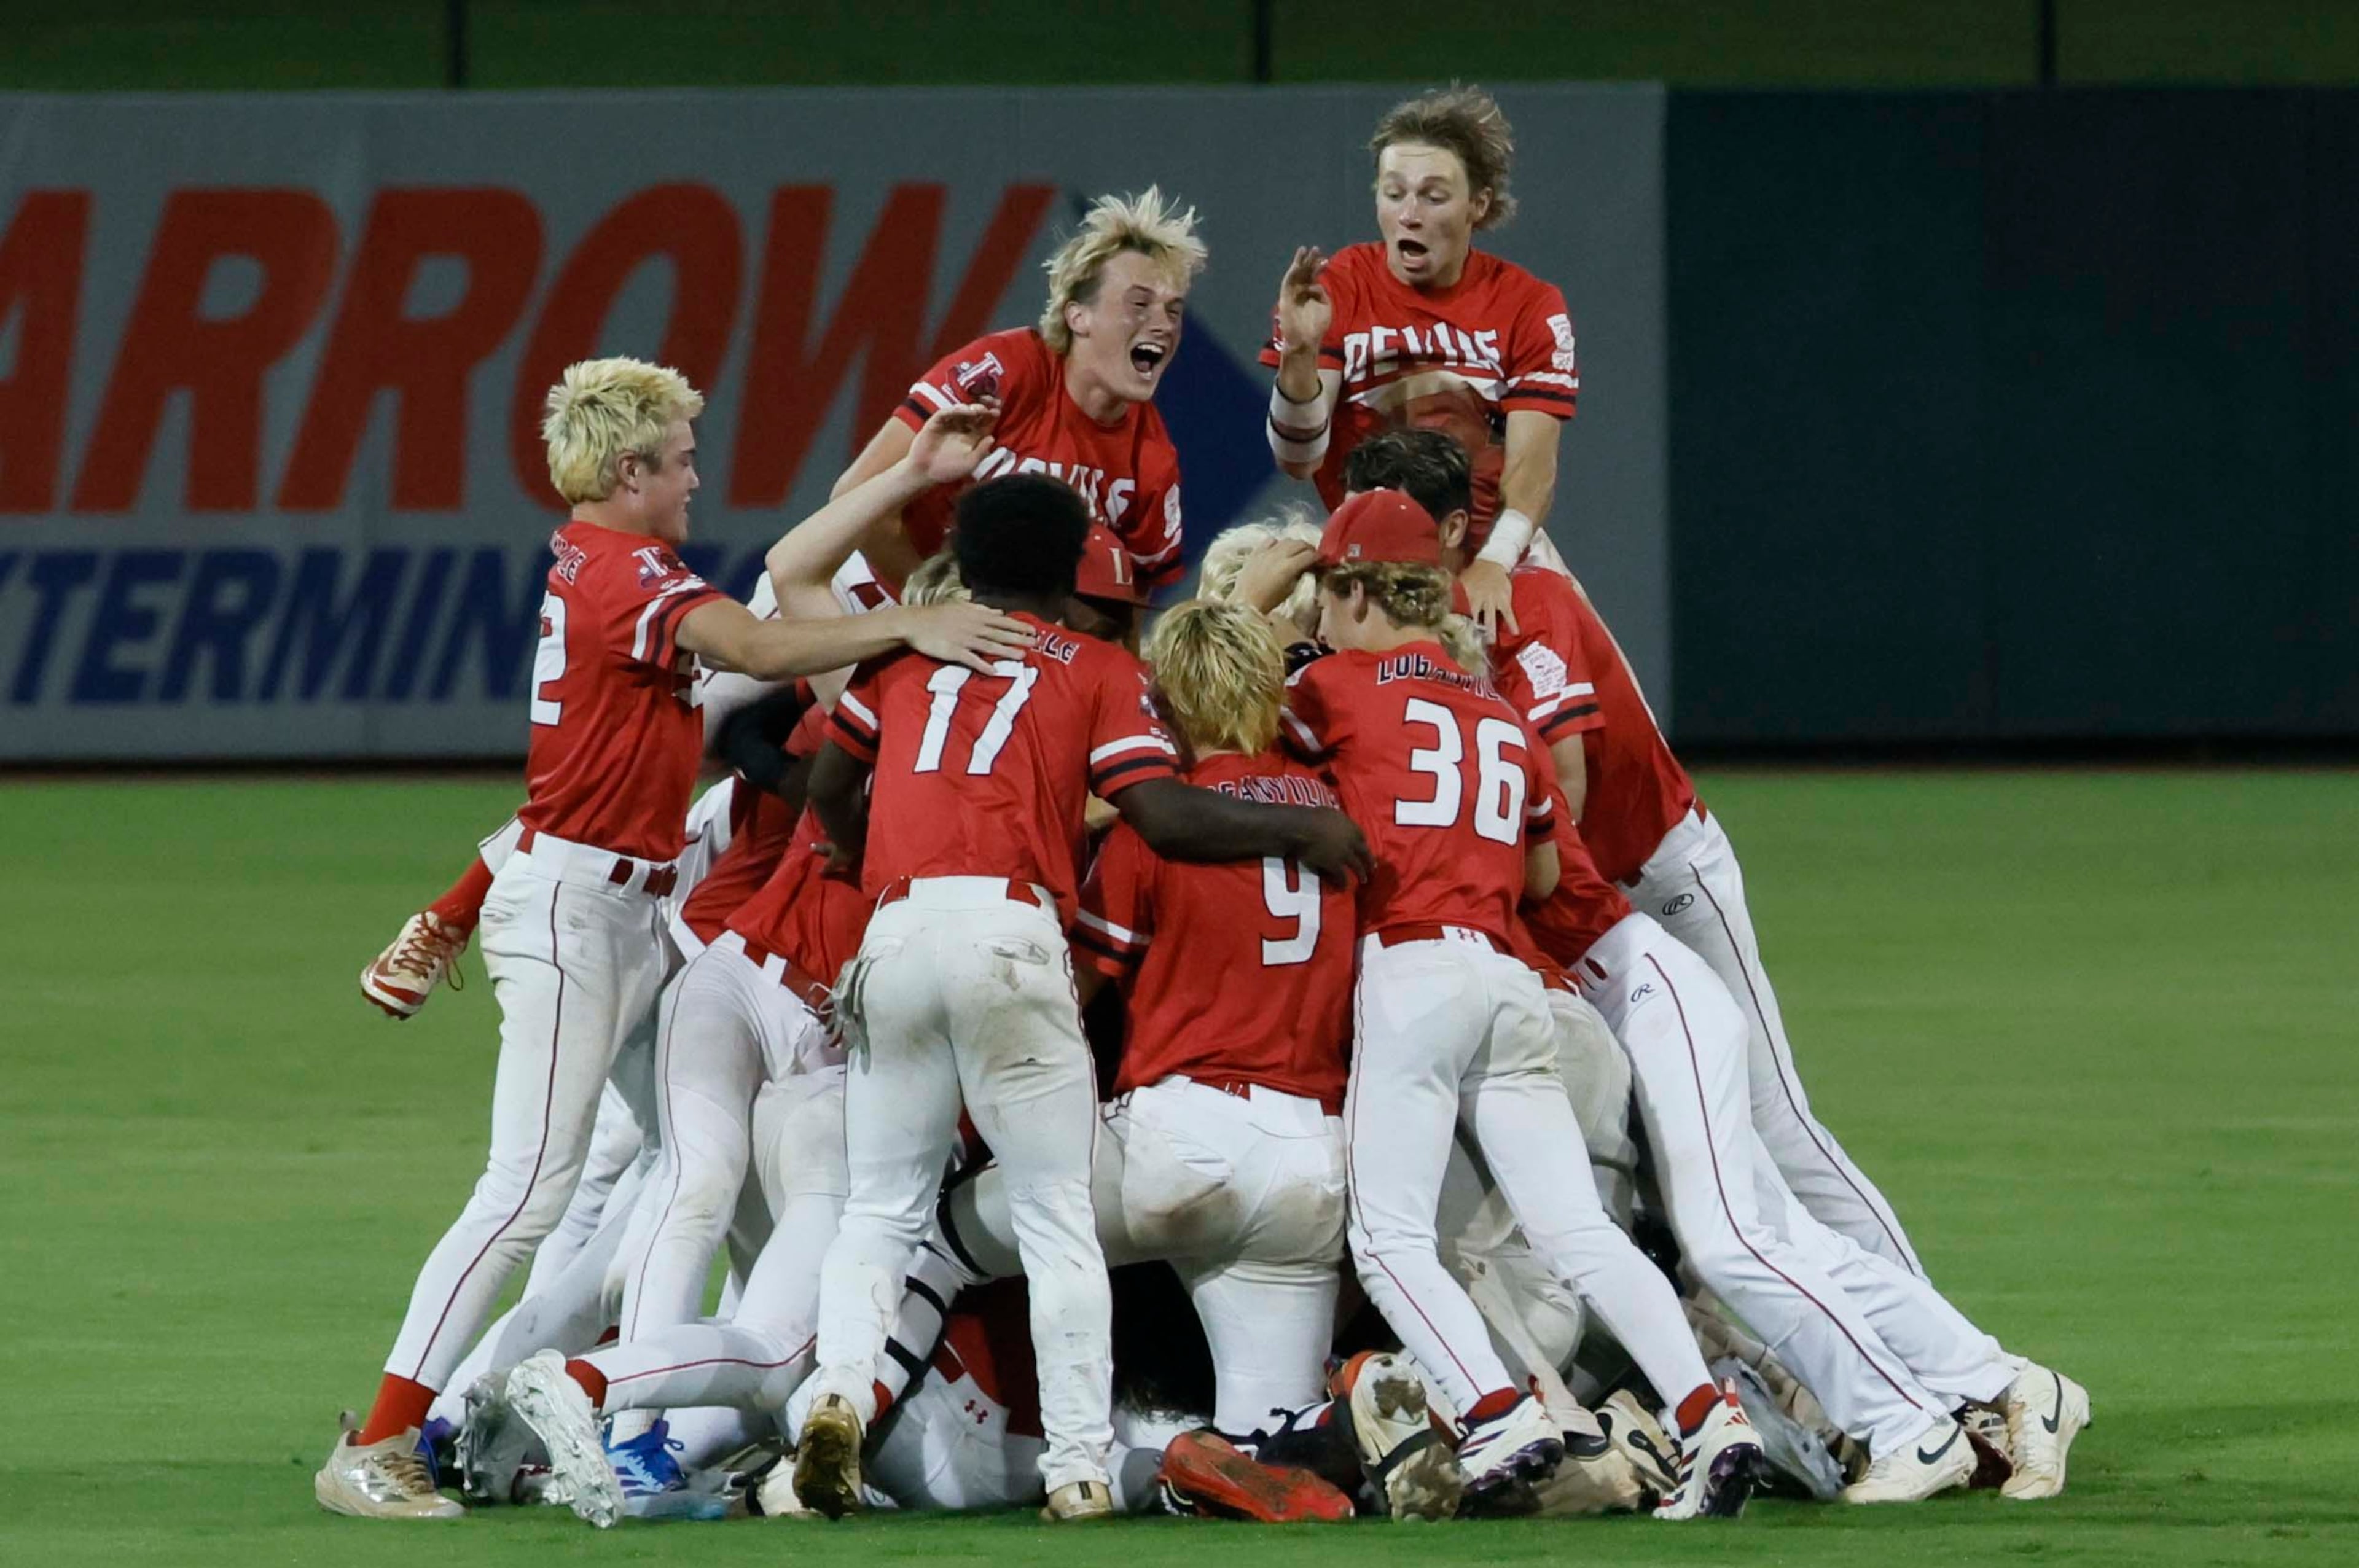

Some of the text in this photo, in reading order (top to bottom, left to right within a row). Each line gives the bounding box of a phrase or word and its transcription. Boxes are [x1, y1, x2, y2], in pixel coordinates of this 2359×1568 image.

[913, 660, 1039, 774] 17
[1395, 697, 1528, 846] 36
[1262, 856, 1321, 966] 9
